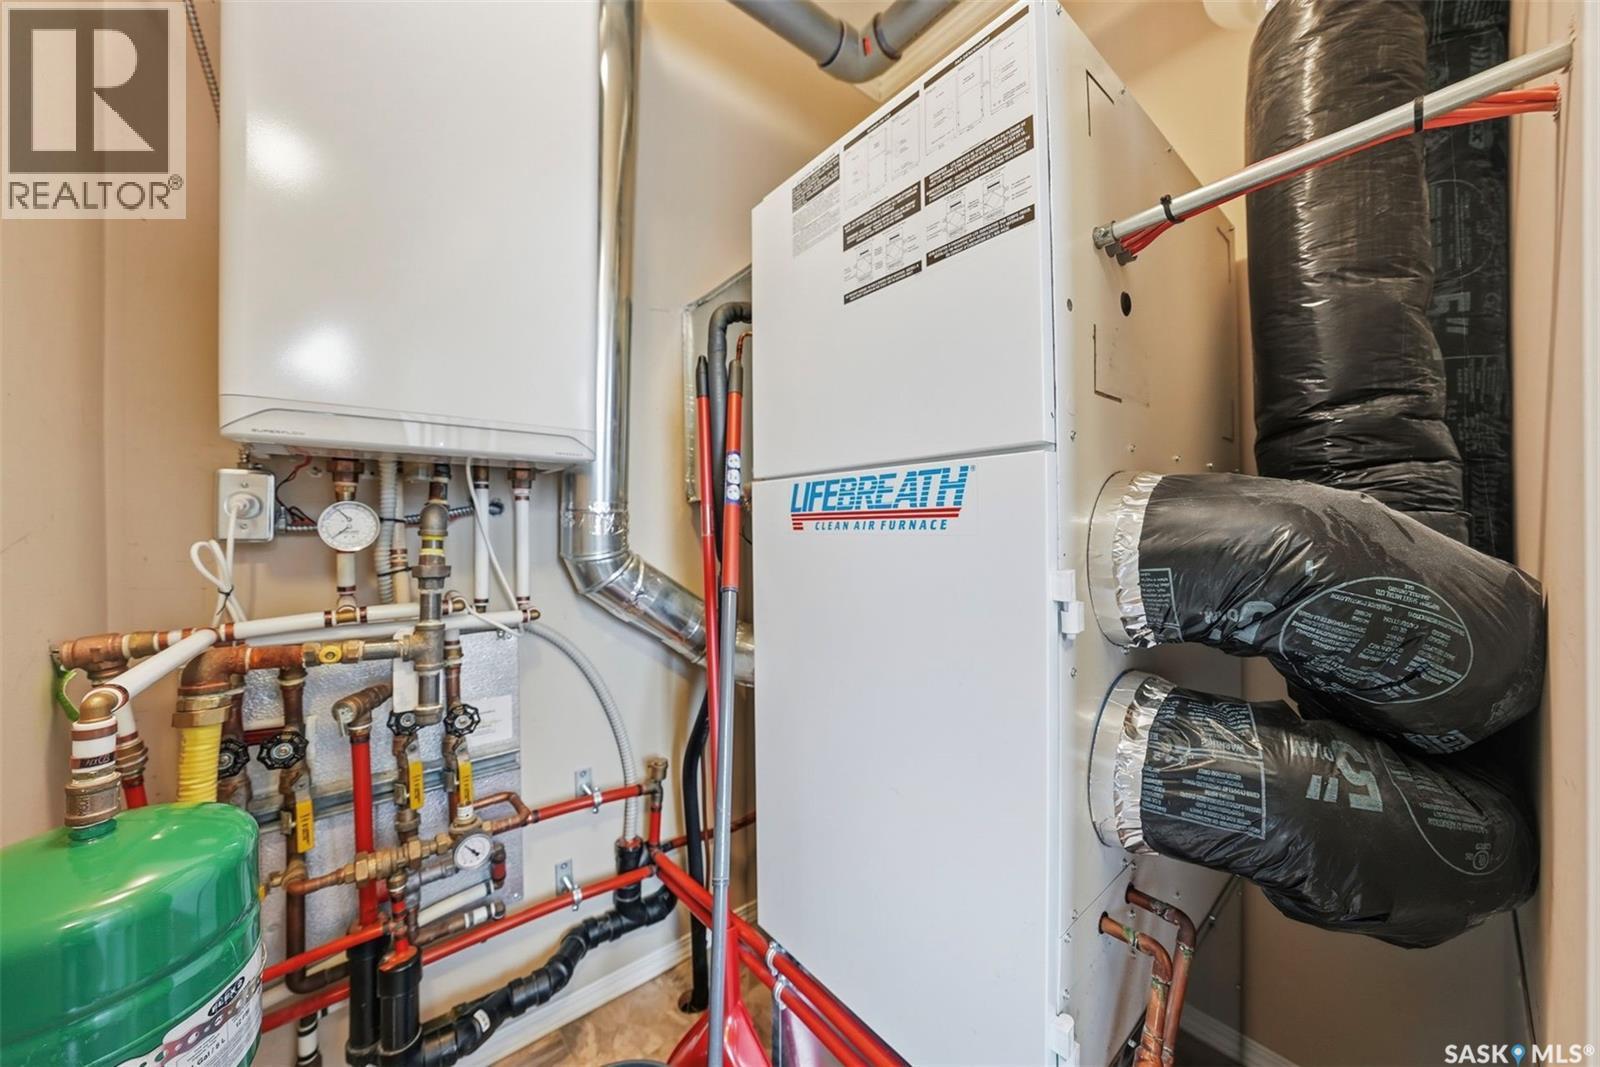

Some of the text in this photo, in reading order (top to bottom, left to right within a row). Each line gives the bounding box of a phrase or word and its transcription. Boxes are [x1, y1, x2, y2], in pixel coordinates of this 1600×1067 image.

[815, 518, 948, 532] CLEAN AIR FURNACE
